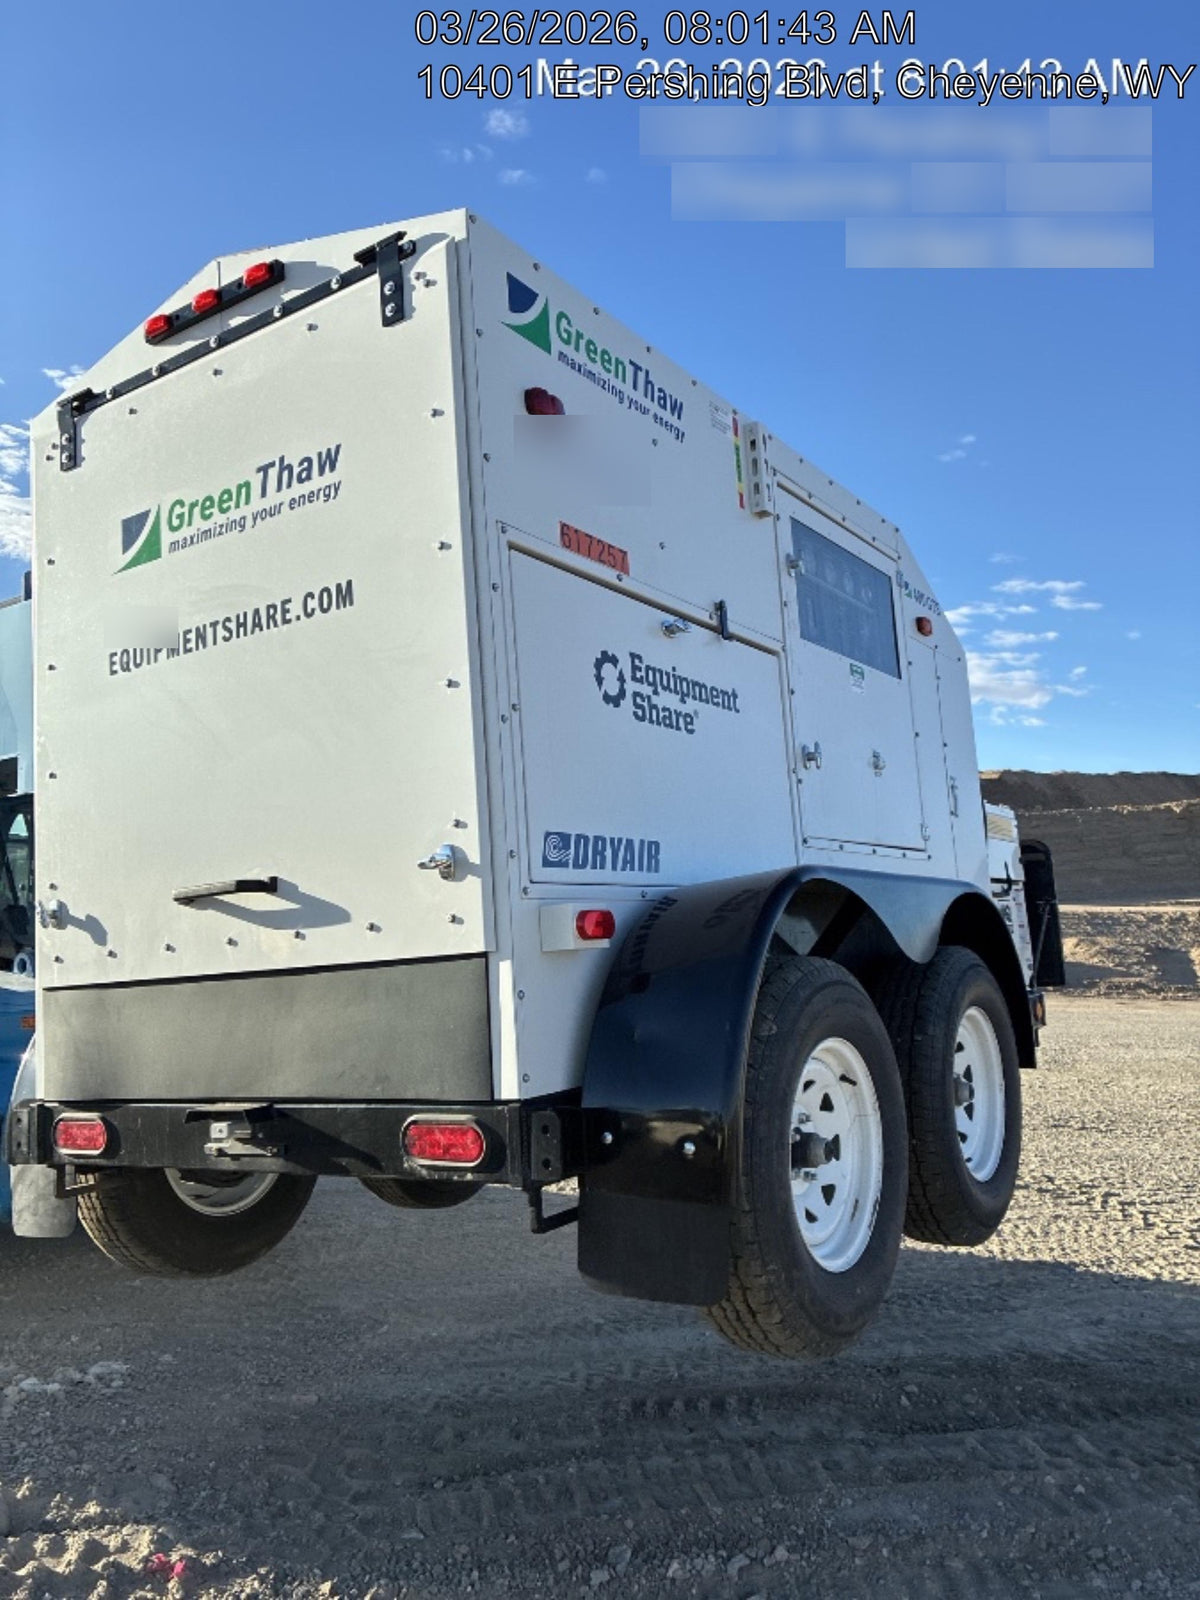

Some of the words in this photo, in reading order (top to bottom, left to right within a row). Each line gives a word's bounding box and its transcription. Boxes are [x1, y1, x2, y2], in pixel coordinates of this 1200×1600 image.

[557, 350, 625, 405] maximizing
[627, 394, 650, 417] your
[652, 411, 686, 444] energy
[168, 513, 247, 555] maximizing
[251, 500, 285, 529] your
[288, 479, 342, 511] energy
[560, 522, 628, 574] 617257
[108, 578, 355, 676] EQUIPMENTSHARE.COM
[629, 651, 740, 714] Equipment
[572, 833, 660, 874] DRYAIR
